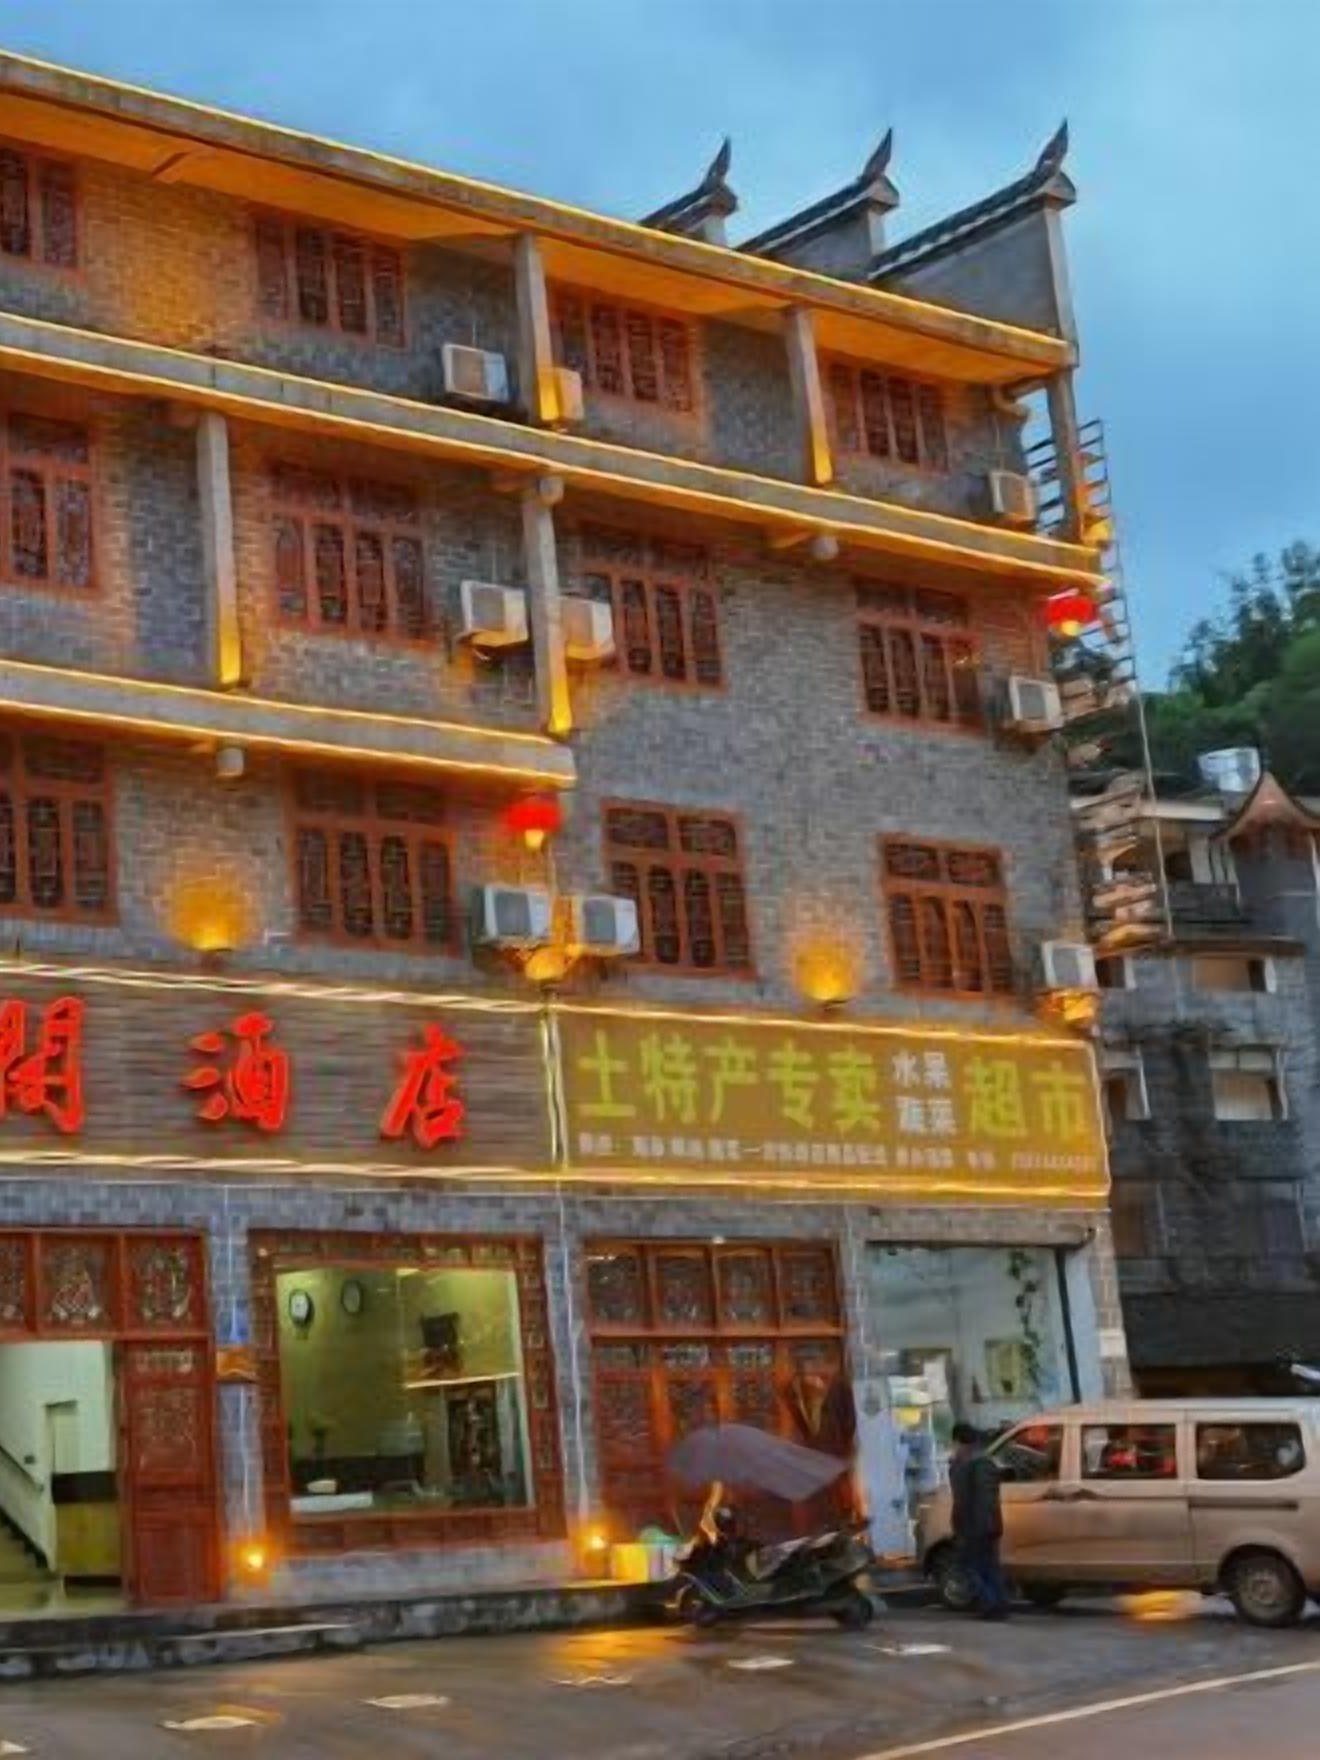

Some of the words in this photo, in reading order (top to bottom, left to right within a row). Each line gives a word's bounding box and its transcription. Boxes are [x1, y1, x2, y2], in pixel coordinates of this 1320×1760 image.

[577, 1029, 880, 1136] 土特产专卖
[964, 1055, 1088, 1139] 超市
[892, 1049, 951, 1090] 水果
